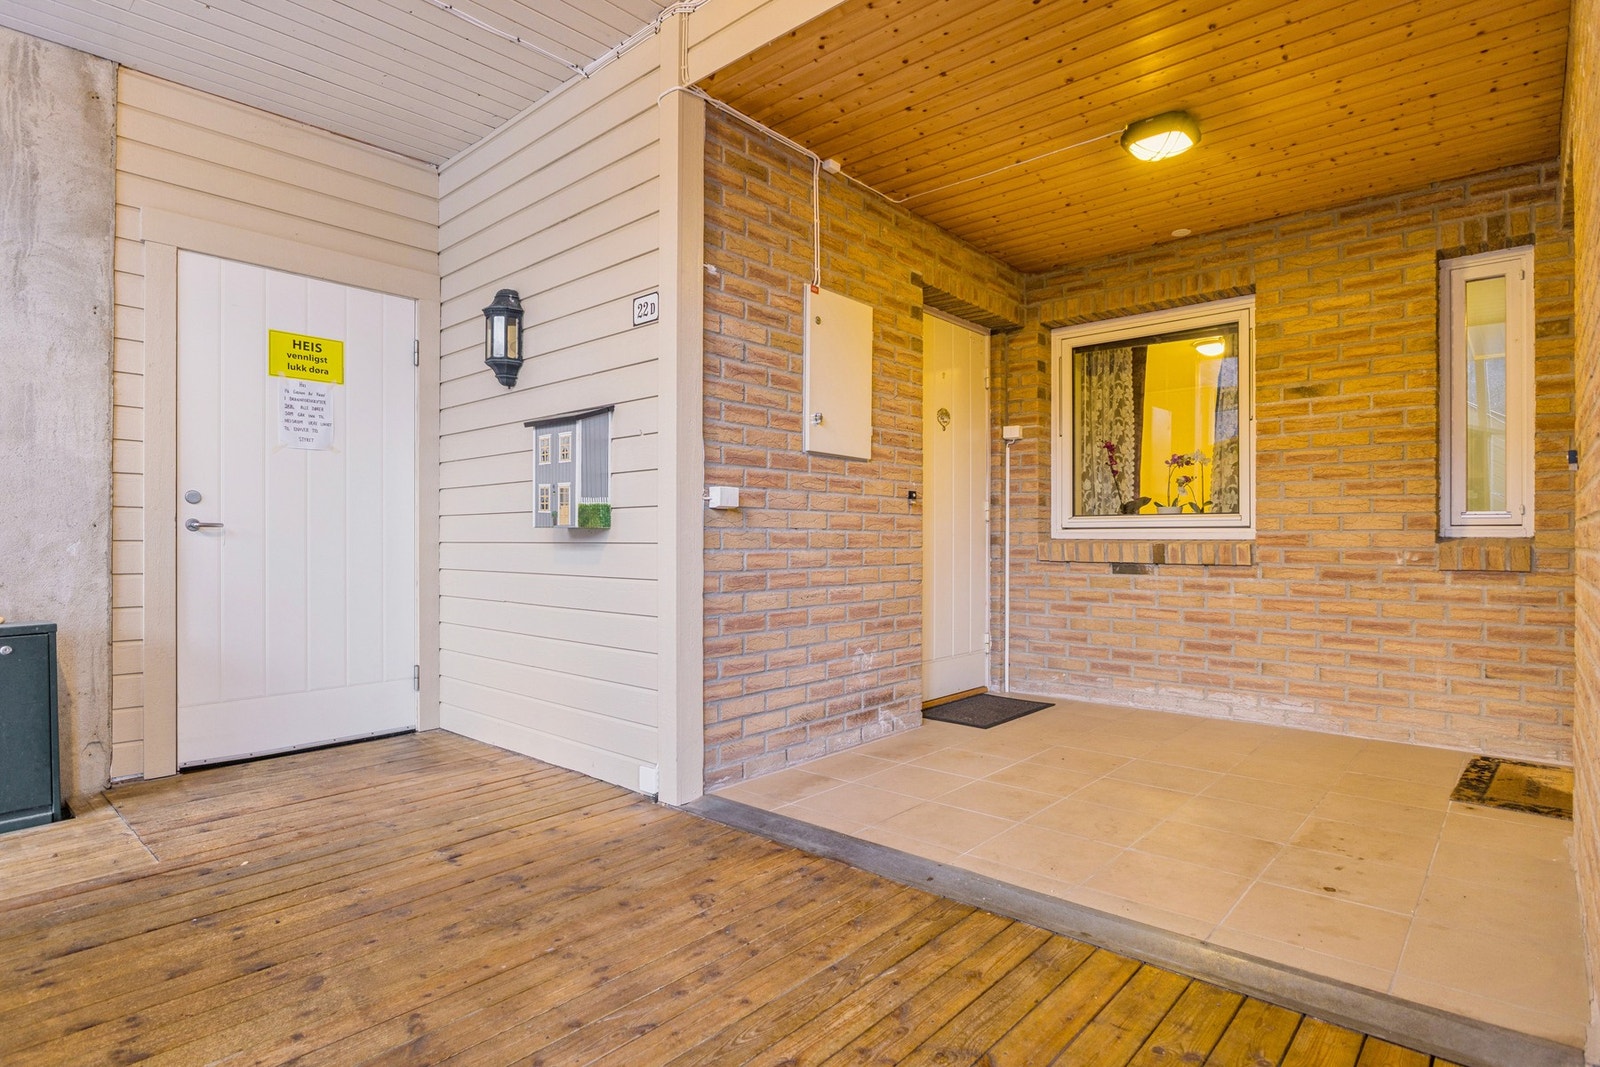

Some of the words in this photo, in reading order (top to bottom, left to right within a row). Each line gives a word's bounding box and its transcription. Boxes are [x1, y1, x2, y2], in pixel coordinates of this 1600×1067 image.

[292, 339, 322, 353] HEIS
[286, 352, 328, 364] vennligst
[287, 363, 307, 372] lukk
[309, 366, 329, 375] døra
